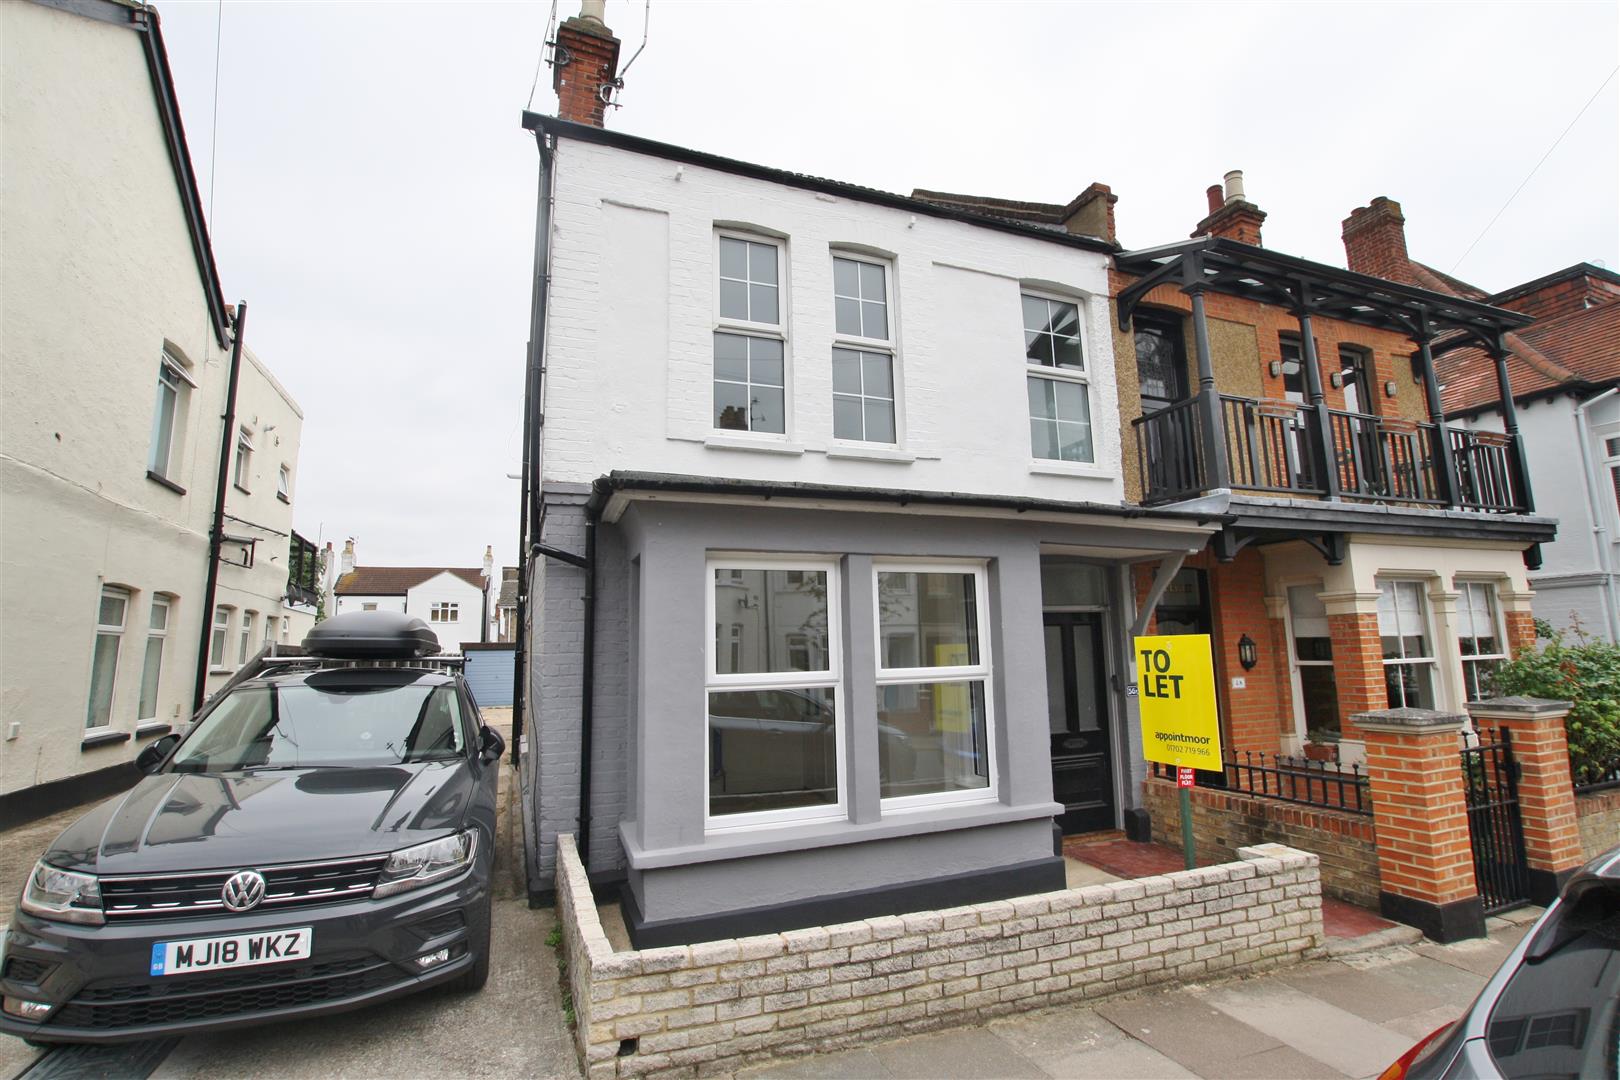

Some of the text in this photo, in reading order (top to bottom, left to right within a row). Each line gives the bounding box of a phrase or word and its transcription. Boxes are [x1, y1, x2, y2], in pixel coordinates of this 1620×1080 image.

[1140, 649, 1171, 673] TO
[1143, 674, 1184, 699] LET
[1154, 731, 1211, 745] appointmoor
[1166, 744, 1210, 756] 01702 719 966
[175, 940, 239, 969] MJ18
[248, 932, 301, 960] WKZ
